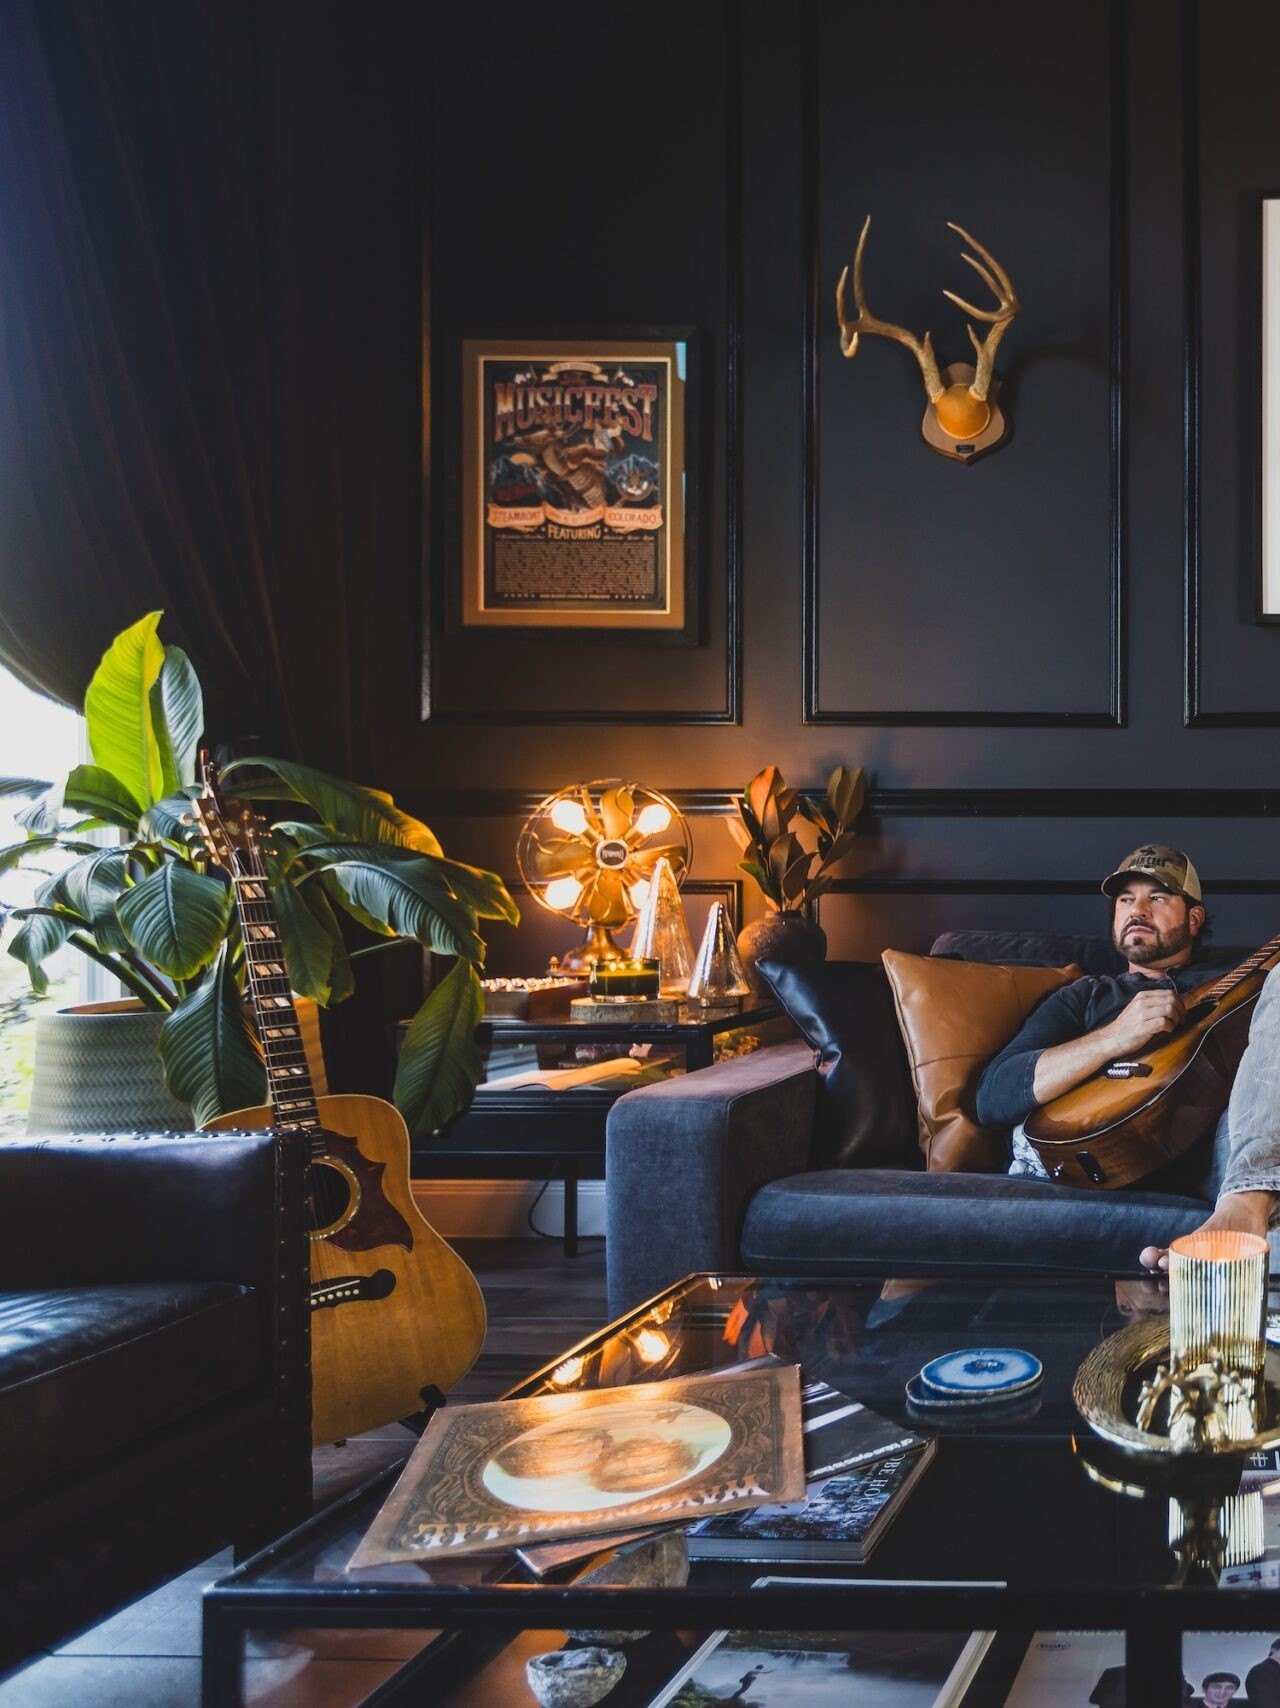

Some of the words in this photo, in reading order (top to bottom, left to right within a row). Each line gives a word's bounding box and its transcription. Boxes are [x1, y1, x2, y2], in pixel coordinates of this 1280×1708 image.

[494, 383, 658, 442] MUSICFEST
[493, 510, 542, 522] STEAMBOAT
[609, 510, 657, 524] COLORADO
[547, 524, 601, 540] FEATURING
